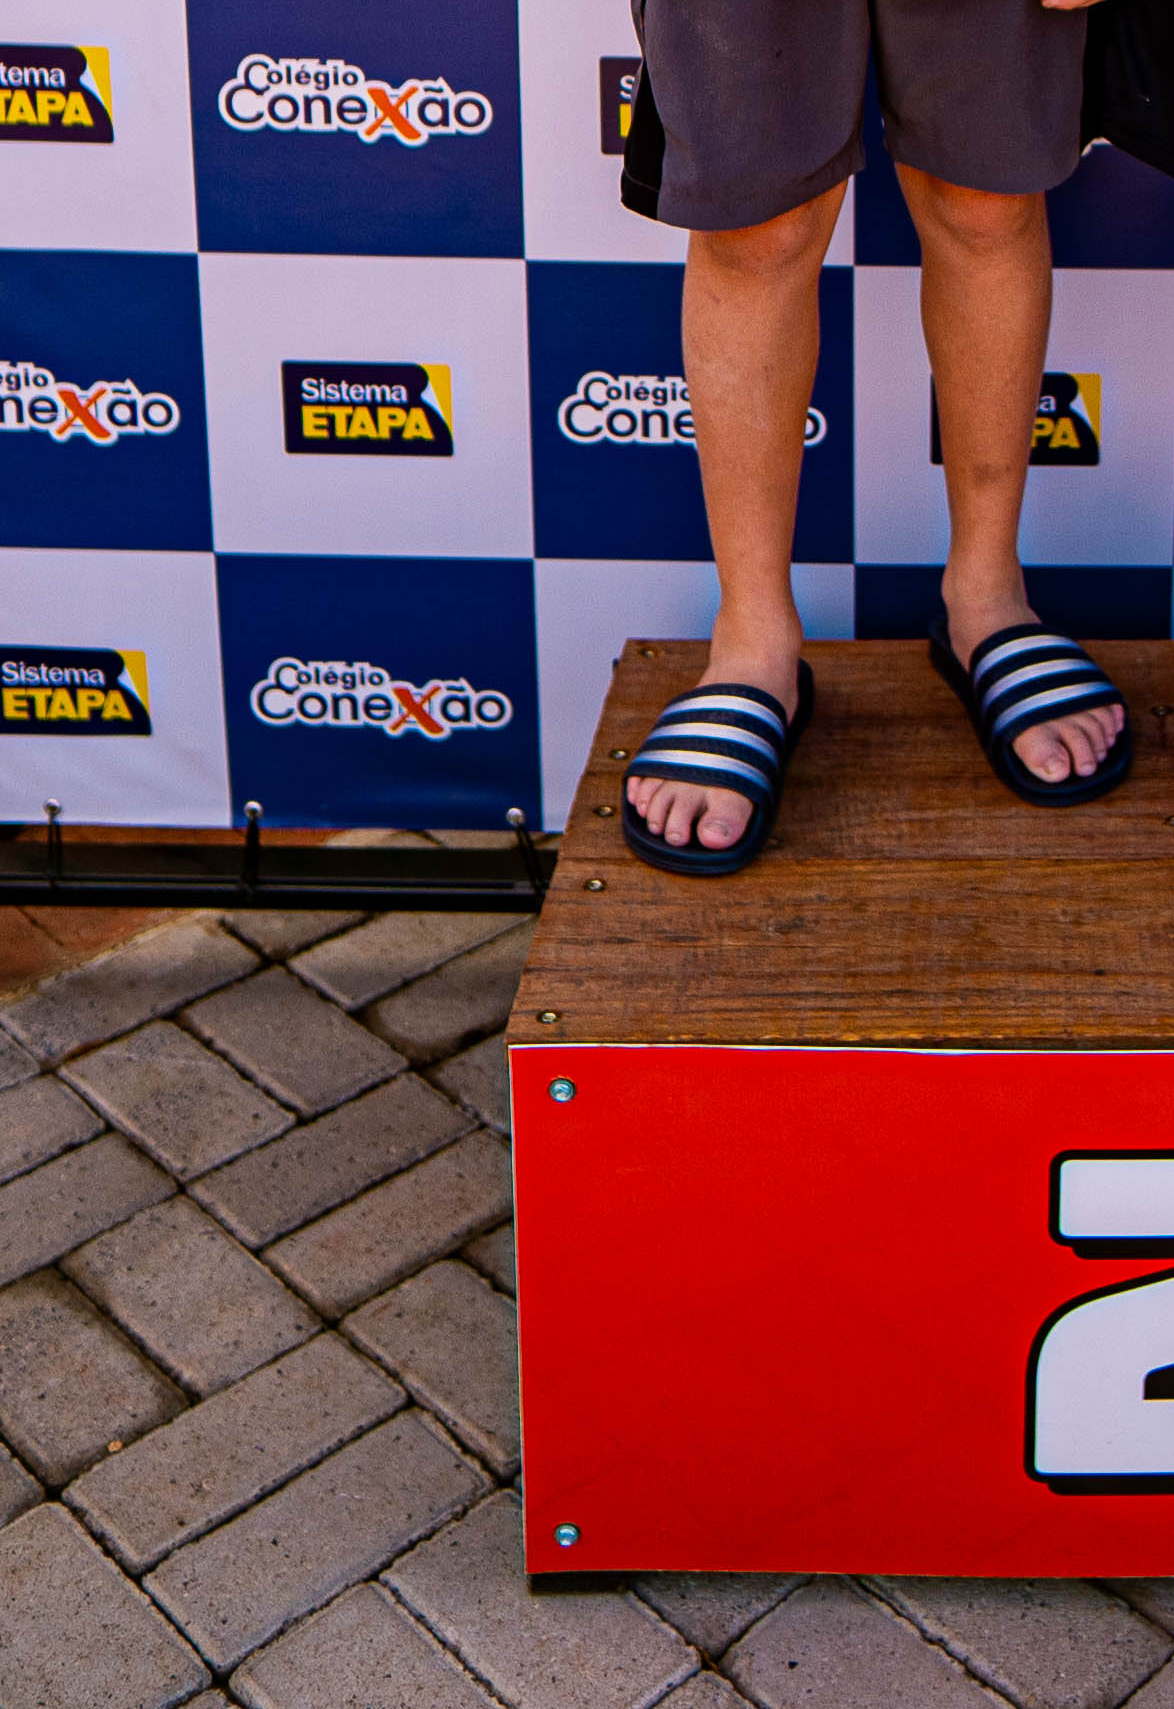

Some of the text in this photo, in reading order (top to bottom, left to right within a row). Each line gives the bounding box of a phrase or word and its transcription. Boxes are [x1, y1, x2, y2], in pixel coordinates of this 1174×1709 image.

[0, 64, 65, 87] tema
[245, 59, 358, 89] Colégio
[0, 91, 93, 126] TAPA
[301, 378, 406, 402] Sistema
[0, 388, 180, 438] neXão
[302, 405, 434, 440] ETAPA
[1, 662, 105, 685] Sistema
[276, 661, 383, 690] Colégio
[2, 690, 132, 722] ETAPA
